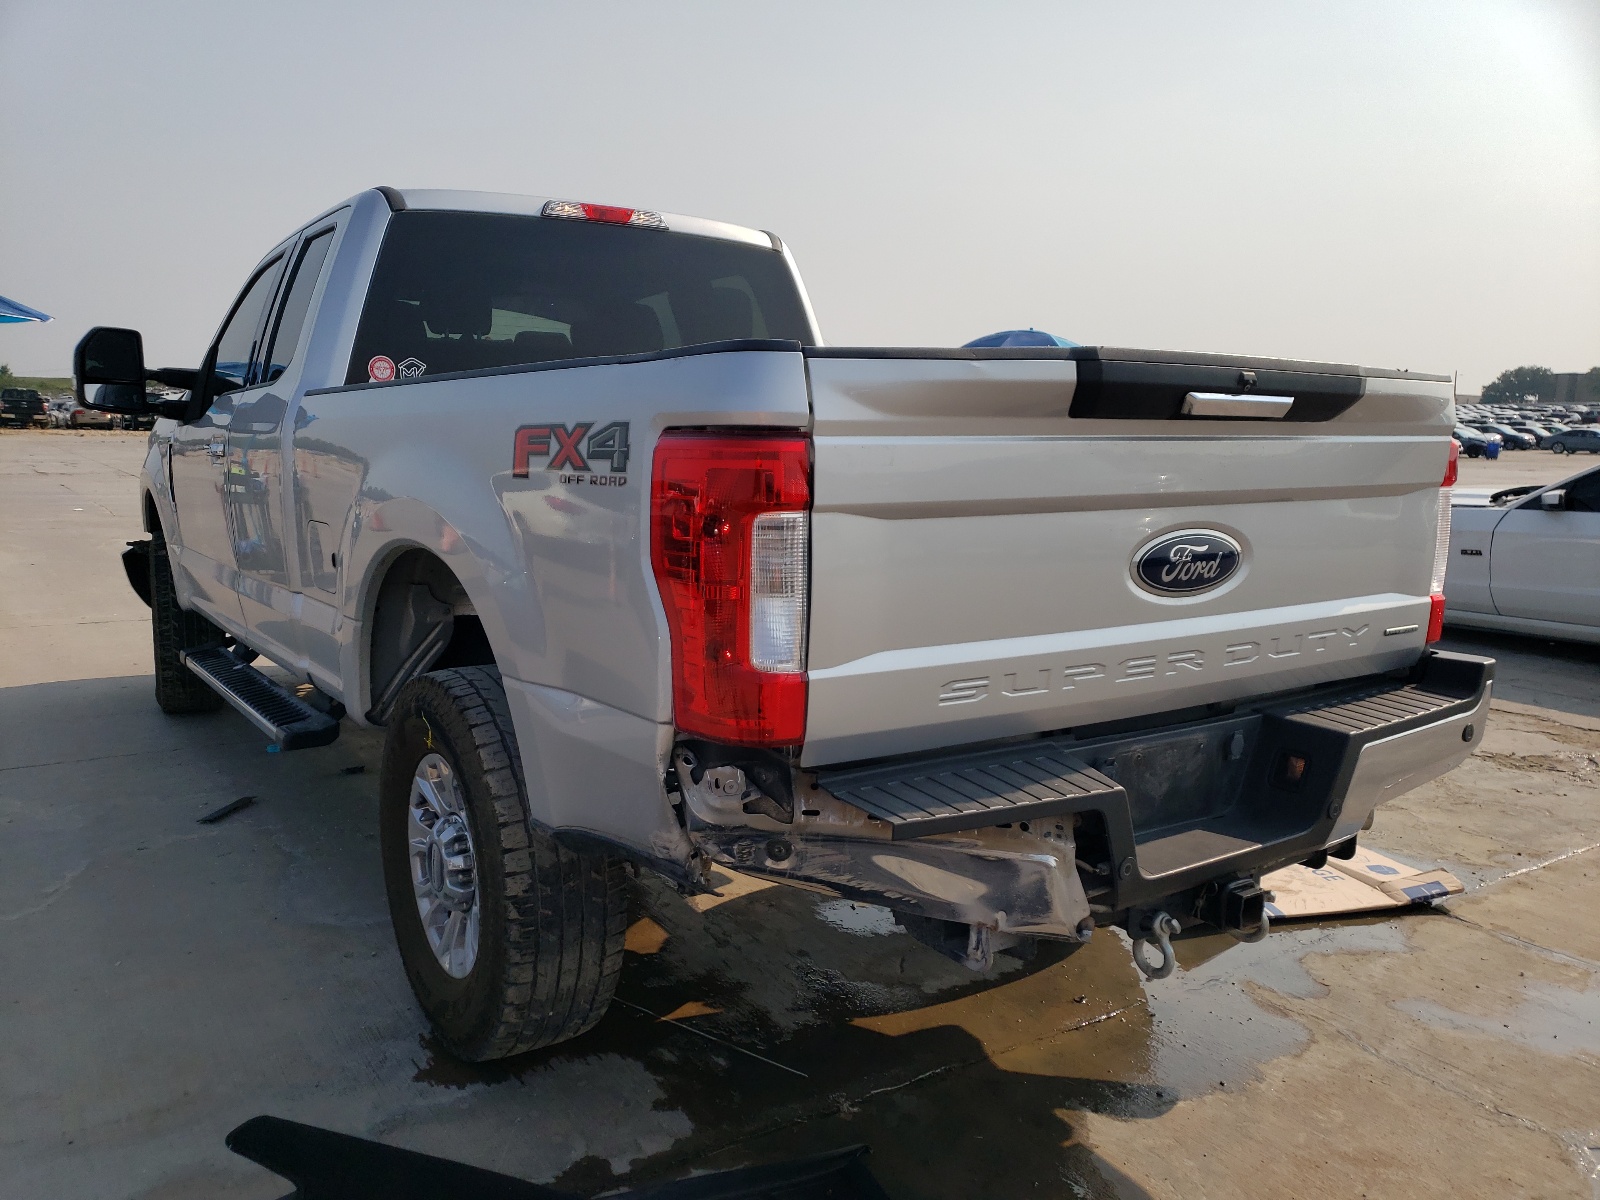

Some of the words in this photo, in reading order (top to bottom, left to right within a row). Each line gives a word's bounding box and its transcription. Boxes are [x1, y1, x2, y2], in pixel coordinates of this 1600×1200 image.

[512, 420, 631, 480] FX4
[559, 474, 585, 486] OFF
[589, 475, 627, 487] ROAD
[1161, 544, 1223, 583] Ford
[938, 649, 1204, 707] SUPER
[1223, 623, 1370, 667] DUTY
